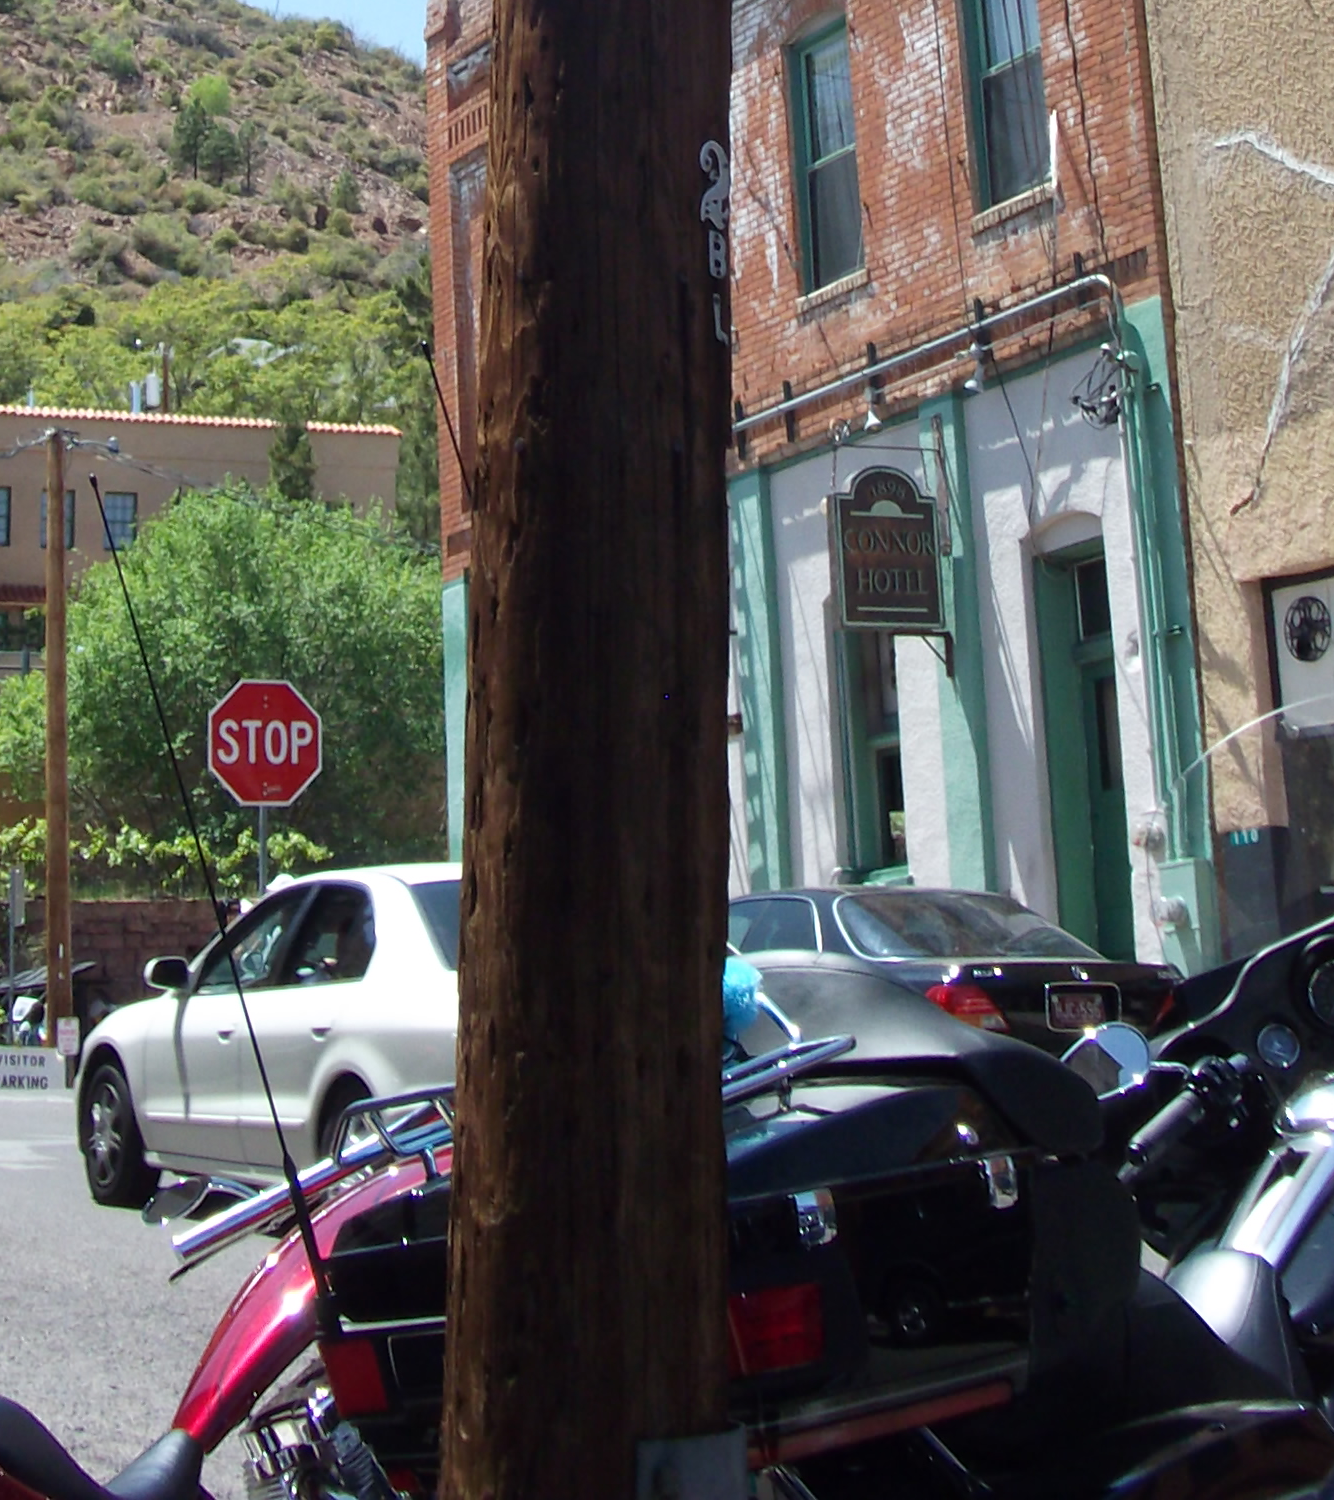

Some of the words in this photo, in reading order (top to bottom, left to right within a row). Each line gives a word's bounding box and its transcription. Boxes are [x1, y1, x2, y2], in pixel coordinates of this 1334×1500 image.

[870, 480, 907, 499] 1898
[844, 528, 935, 555] CONNOR
[857, 567, 929, 595] HOTEL
[217, 719, 313, 764] STOP
